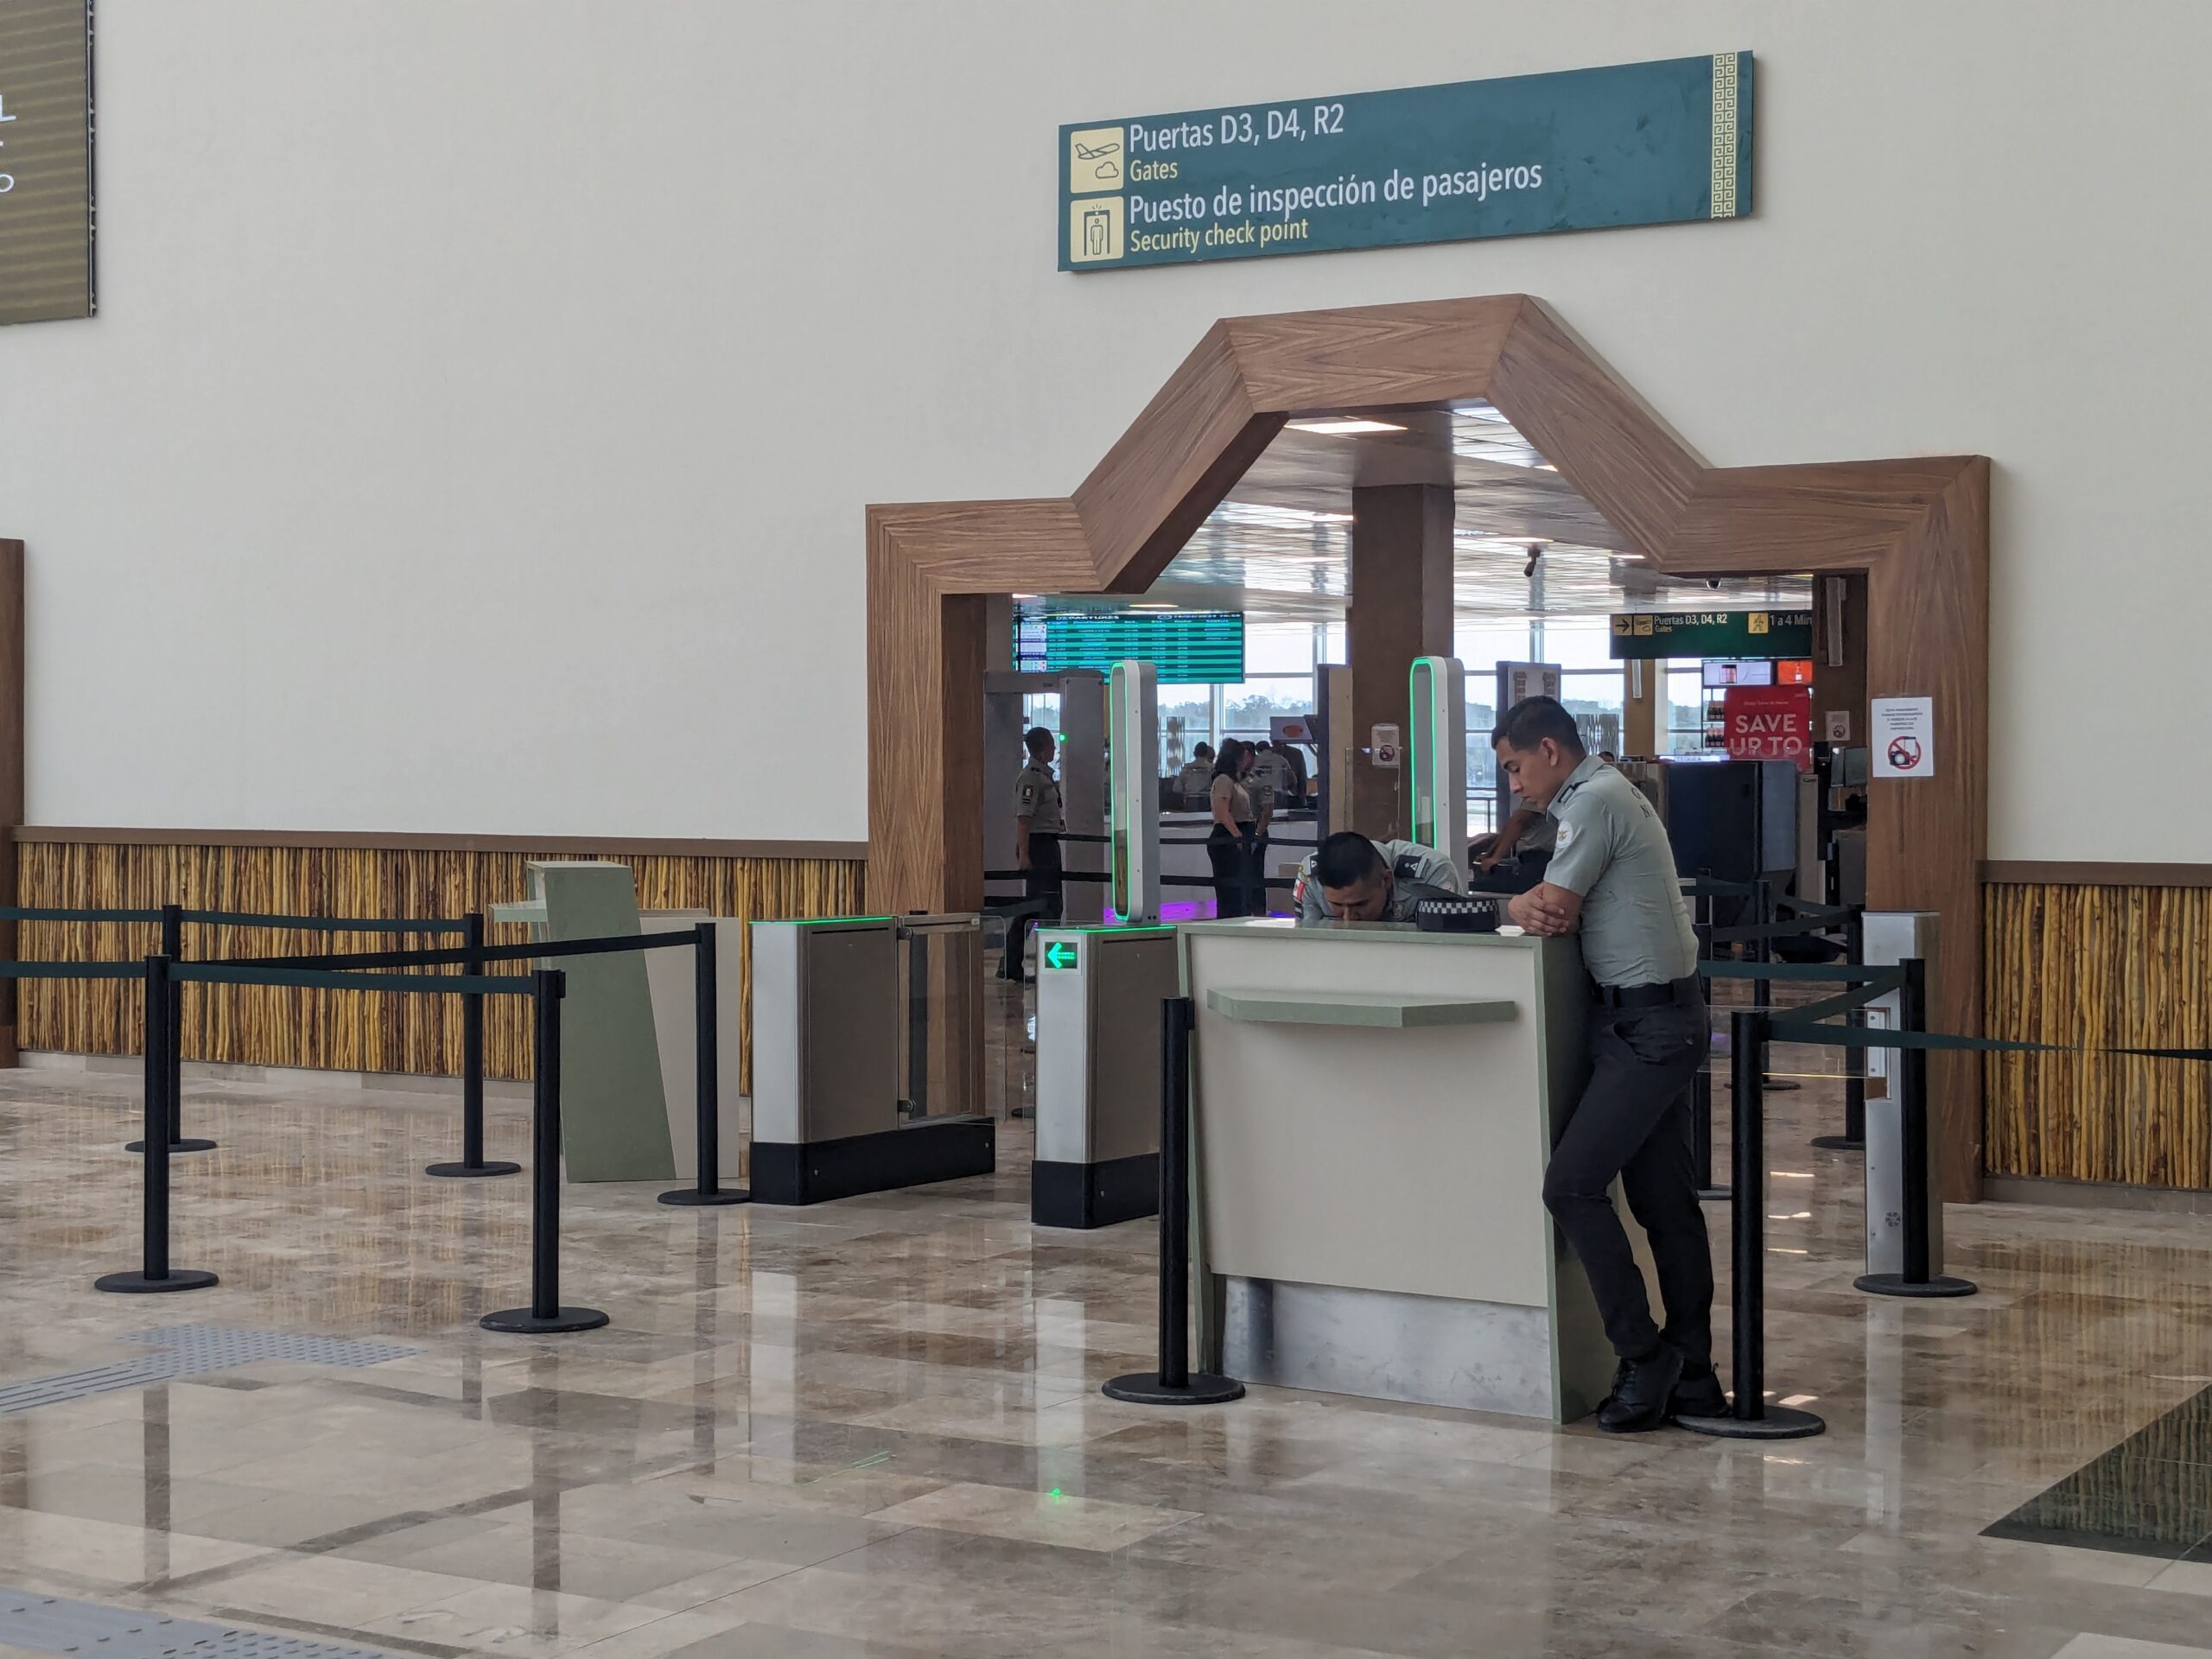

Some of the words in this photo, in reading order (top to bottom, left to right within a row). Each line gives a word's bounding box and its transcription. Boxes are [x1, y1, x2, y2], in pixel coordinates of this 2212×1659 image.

[1129, 121, 1213, 153] Puertas
[1221, 112, 1260, 146] D3,
[1268, 108, 1306, 142] D4,
[1314, 104, 1344, 136] R2
[1129, 159, 1179, 182] Gates
[1130, 191, 1206, 224] Puesto
[1213, 186, 1243, 216] de
[1249, 175, 1376, 219] inspección
[1383, 170, 1414, 202] de
[1421, 162, 1543, 207] pasajeros
[1130, 226, 1199, 254] Security
[1205, 220, 1255, 246] check
[1260, 218, 1308, 248] point
[1654, 616, 1684, 626] Puertas
[1685, 615, 1700, 626] D3,
[1700, 614, 1715, 625] D4,
[1716, 614, 1727, 624] R2
[1784, 614, 1792, 625] 4
[1735, 714, 1797, 734] SAVE
[1730, 737, 1762, 756] UP
[1767, 736, 1803, 756] TO
